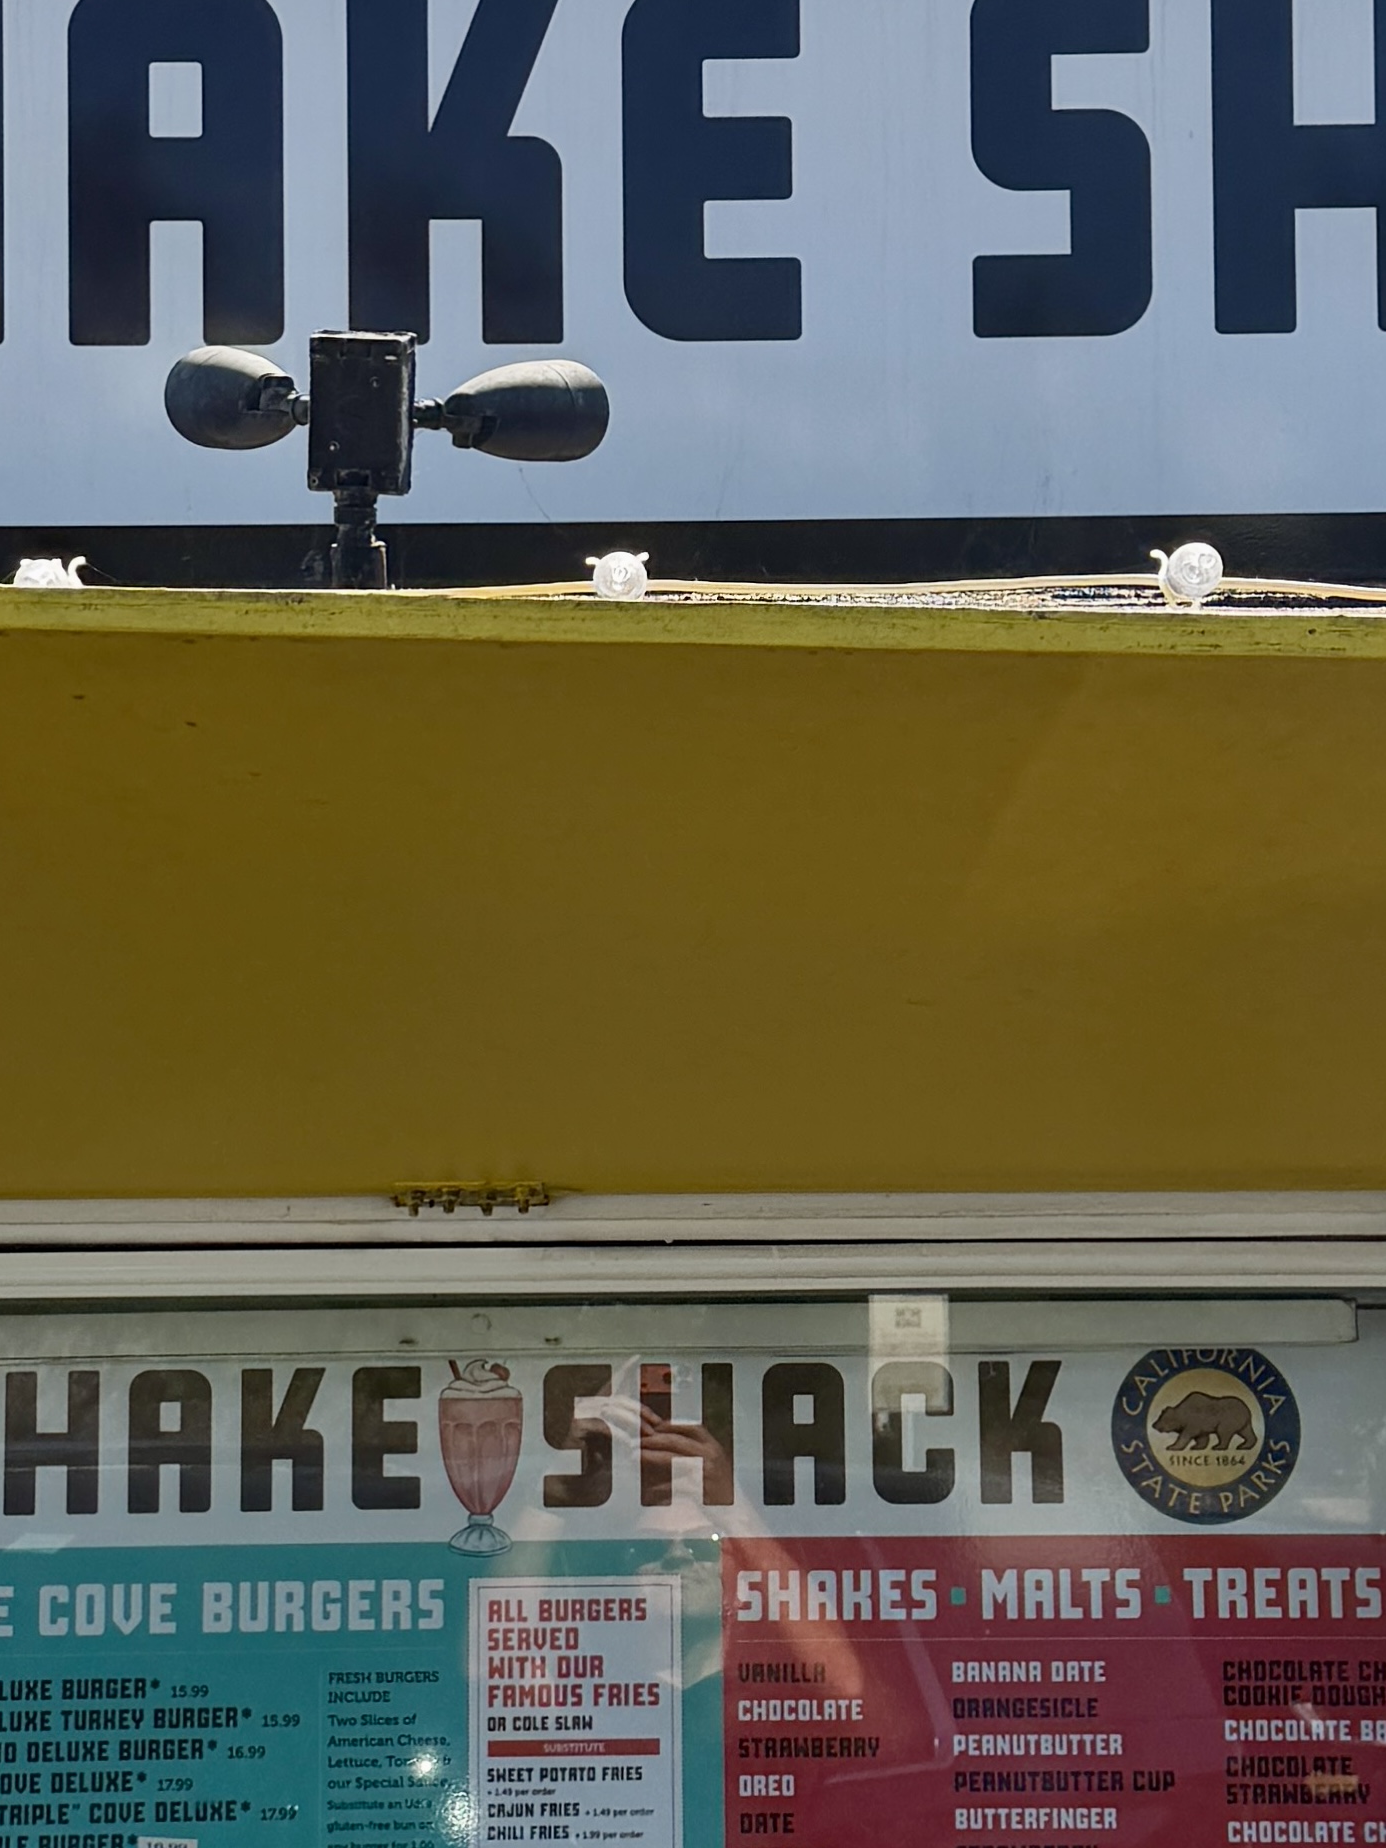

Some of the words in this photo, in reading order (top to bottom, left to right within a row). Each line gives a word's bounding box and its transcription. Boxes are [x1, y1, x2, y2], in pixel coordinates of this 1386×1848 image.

[543, 1360, 1066, 1509] SHACK
[1169, 1456, 1209, 1466] SINCE
[1216, 1456, 1246, 1465] 1864
[1121, 1439, 1202, 1514] STATE
[1219, 1439, 1290, 1512] PARKS
[737, 1570, 937, 1621] SHAKES
[982, 1569, 1141, 1620] MALTS
[1184, 1568, 1383, 1619] TREATS
[39, 1584, 177, 1637] COVE
[202, 1579, 444, 1633] BURGERS
[488, 1600, 527, 1622] ALL
[539, 1598, 647, 1622] BURGERS
[488, 1628, 579, 1650] SERVED
[328, 1672, 371, 1685] FRESH
[376, 1671, 439, 1684] BURGERS
[488, 1657, 546, 1679] WITH
[557, 1655, 603, 1678] OUR
[739, 1663, 826, 1684] VANILLA
[952, 1661, 1041, 1683] BANANA
[1052, 1661, 1105, 1682] DATE
[171, 1686, 209, 1698] 15.99
[328, 1691, 390, 1703] INCLUDE
[488, 1684, 583, 1708] FAMOUS
[593, 1682, 660, 1707] FRIES
[61, 1709, 144, 1731] TURKEY
[261, 1714, 300, 1727] 15.99
[328, 1715, 356, 1726] Two
[361, 1714, 398, 1726] Slices
[402, 1712, 416, 1725] of
[738, 1700, 863, 1721] CHOCOLATE
[1224, 1720, 1351, 1742] CHOCOLATE
[26, 1740, 109, 1762] DELUXE
[227, 1746, 265, 1759] 16.99
[739, 1737, 880, 1758] STRAWBERRY
[953, 1734, 1123, 1756] PEANUTBUTTER
[158, 1778, 193, 1791] 17.99
[488, 1768, 534, 1782] SWEET
[539, 1767, 596, 1782] POTATO
[602, 1767, 642, 1781] FRIES
[739, 1775, 794, 1797] OREO
[740, 1813, 794, 1834] DATE
[955, 1808, 1117, 1829] BUTTERFINGER
[1228, 1822, 1354, 1843] CHOCOLATE
